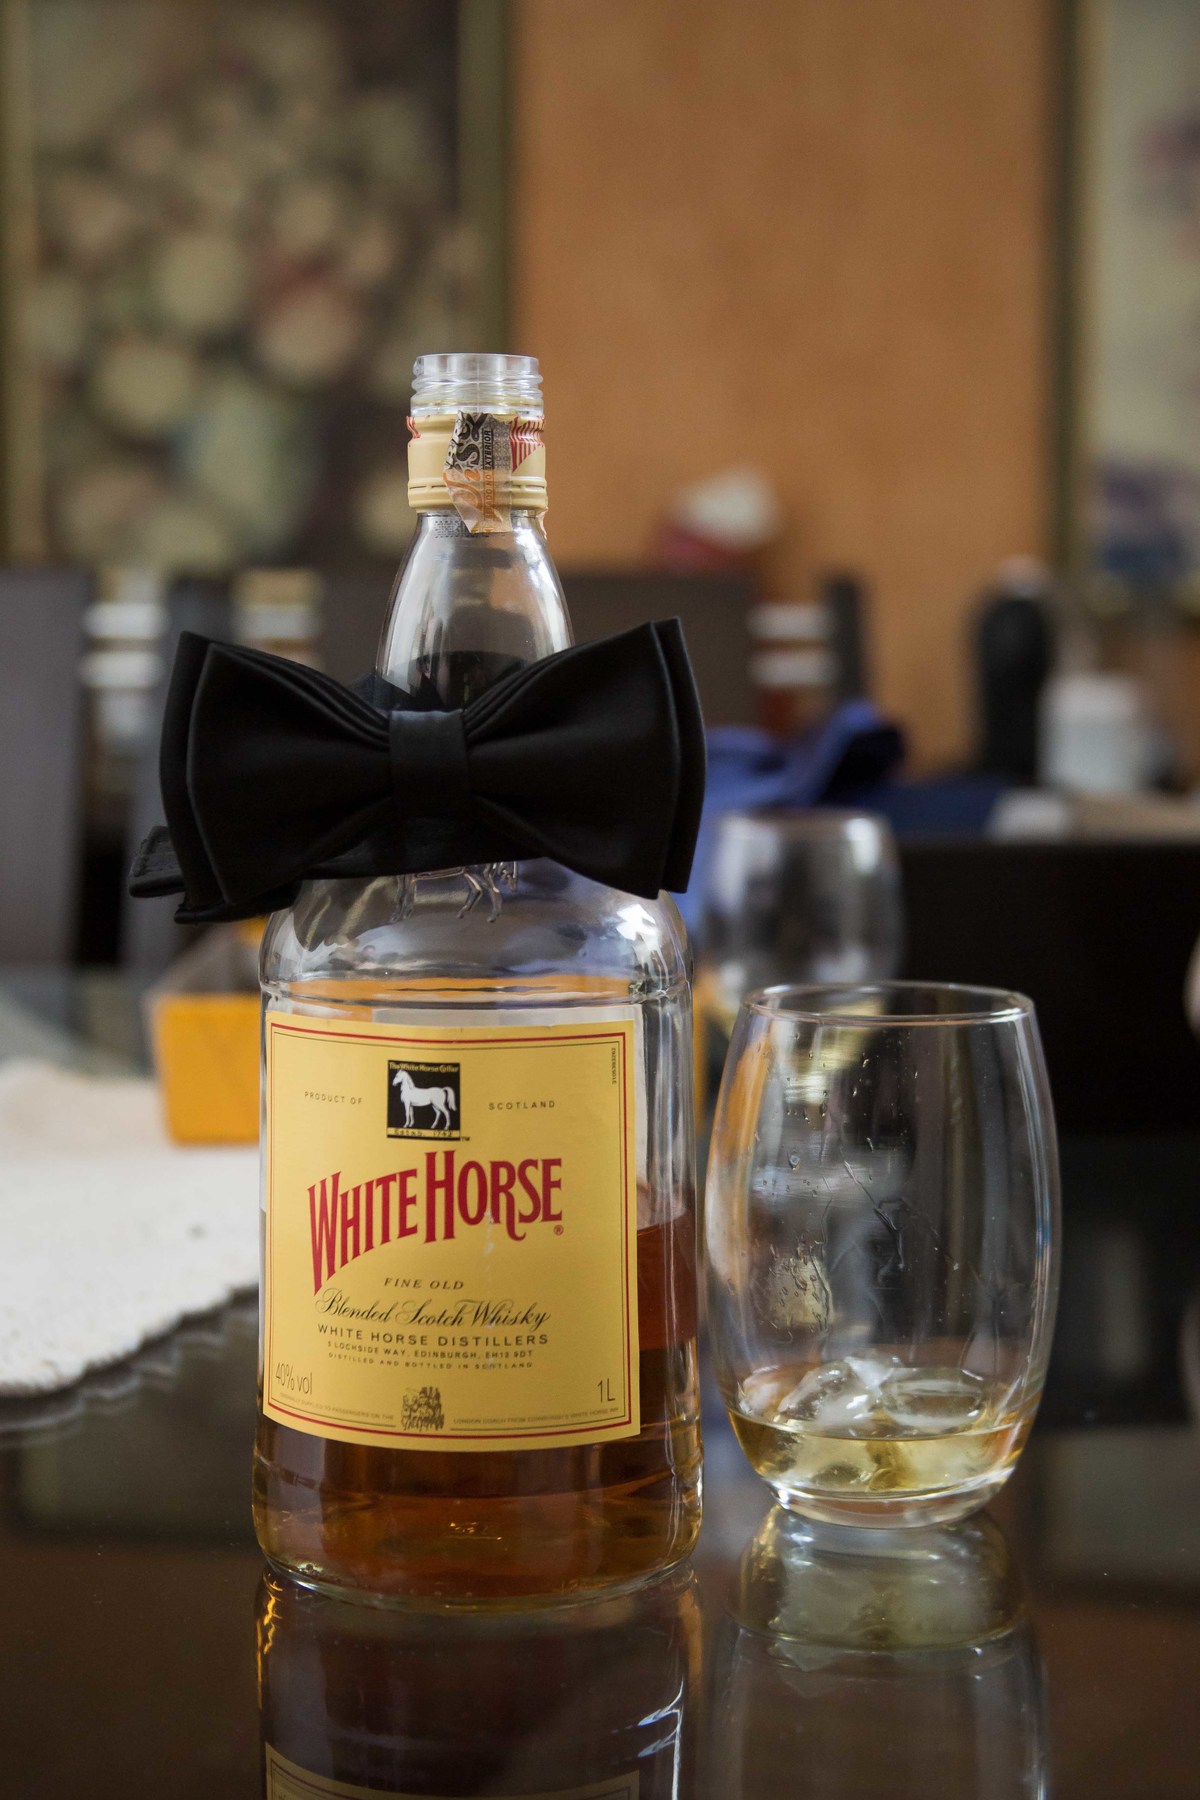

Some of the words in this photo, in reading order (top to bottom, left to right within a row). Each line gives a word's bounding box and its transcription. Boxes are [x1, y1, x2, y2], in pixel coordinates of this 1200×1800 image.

[484, 430, 493, 470] EXTERIOR
[304, 1091, 345, 1103] PRODUCT
[350, 1097, 363, 1105] OF
[488, 1100, 555, 1111] SCOTLAND
[307, 1170, 418, 1296] WHITE
[423, 1149, 563, 1242] HORSE
[384, 1277, 422, 1289] FINE
[429, 1280, 464, 1290] OLD
[315, 1287, 399, 1323] Blended
[395, 1298, 466, 1327] Scotch
[454, 1298, 551, 1333] Whisky
[318, 1324, 363, 1340] WHITE
[371, 1332, 428, 1346] HORSE
[438, 1334, 549, 1347] DISTILLERS
[334, 1342, 379, 1355] LOCHSIDE
[485, 1351, 510, 1359] EH12
[328, 1352, 374, 1364] DISTILLED
[380, 1359, 399, 1367] AND
[405, 1362, 452, 1370] BOTTLED
[475, 1361, 533, 1370] SCOTLAND
[275, 1361, 295, 1392] 40%
[297, 1371, 313, 1395] vol
